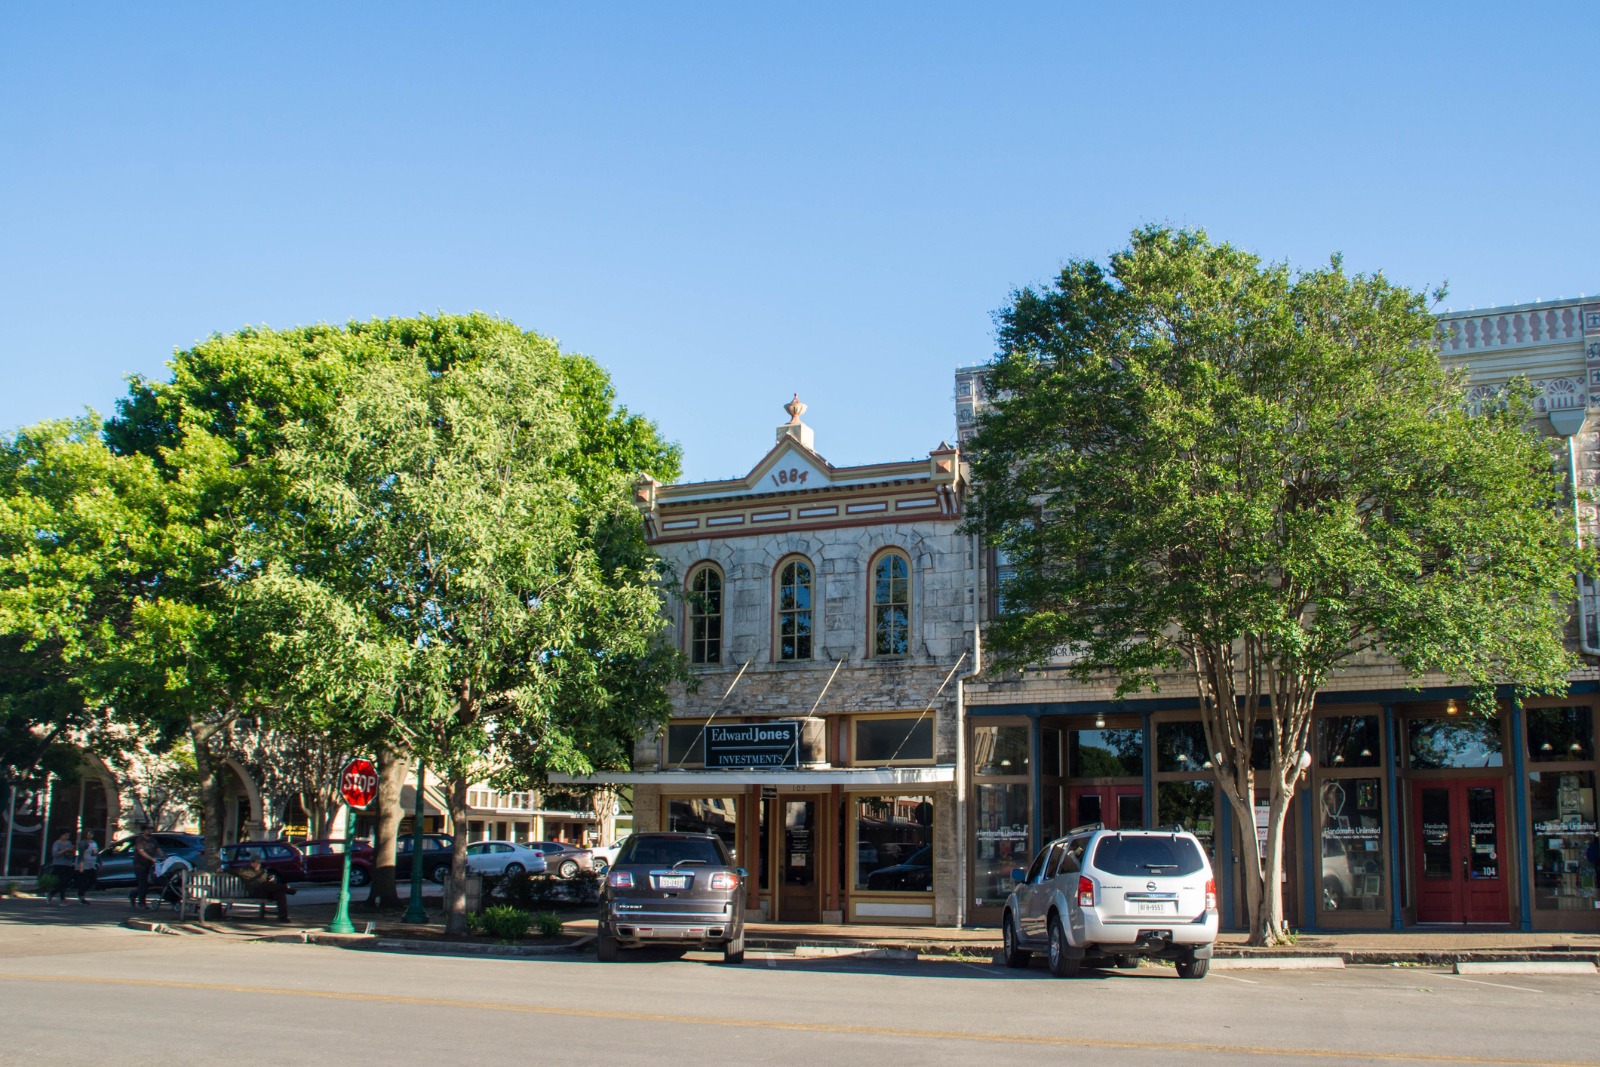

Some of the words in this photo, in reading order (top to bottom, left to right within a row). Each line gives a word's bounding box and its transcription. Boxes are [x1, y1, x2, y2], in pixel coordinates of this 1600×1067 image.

[771, 468, 808, 487] 1884
[719, 754, 783, 764] INVESTMENTS
[343, 772, 376, 793] STOP
[1534, 822, 1568, 831] Handcrafts
[1569, 822, 1596, 830] Unlimited
[1483, 867, 1495, 875] 104
